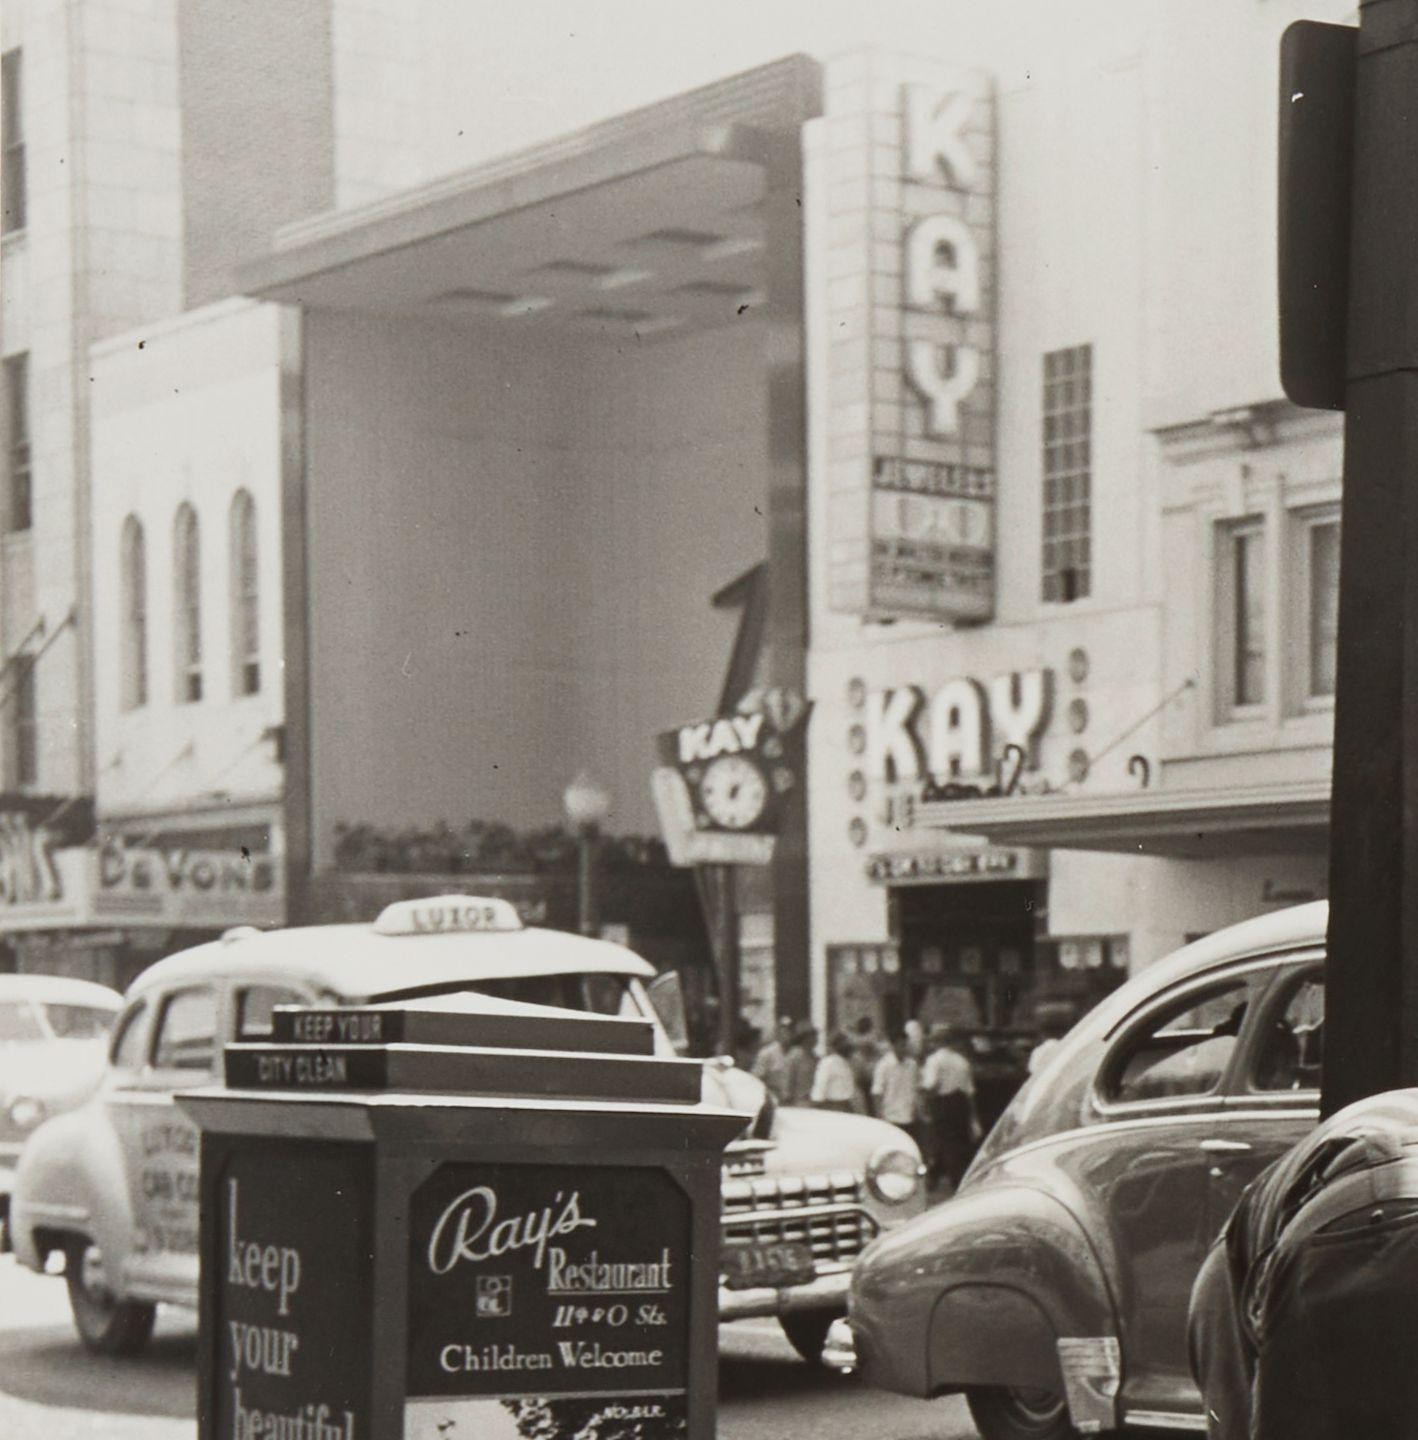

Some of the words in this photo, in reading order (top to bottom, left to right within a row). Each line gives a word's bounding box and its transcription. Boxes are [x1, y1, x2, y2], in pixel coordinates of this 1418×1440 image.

[904, 84, 981, 439] KAY
[679, 713, 764, 764] KAY
[868, 667, 1056, 786] KAY
[293, 1014, 333, 1041] KEEP
[337, 1013, 381, 1041] YOUR
[258, 1055, 292, 1082] CITY
[296, 1055, 347, 1083] CLEAN
[228, 1177, 301, 1316] keep
[428, 1186, 598, 1275] Ray's
[547, 1246, 674, 1292] Restaurant
[606, 1304, 629, 1326] O
[228, 1320, 299, 1382] your
[439, 1343, 553, 1372] Children
[557, 1341, 664, 1368] Welcome
